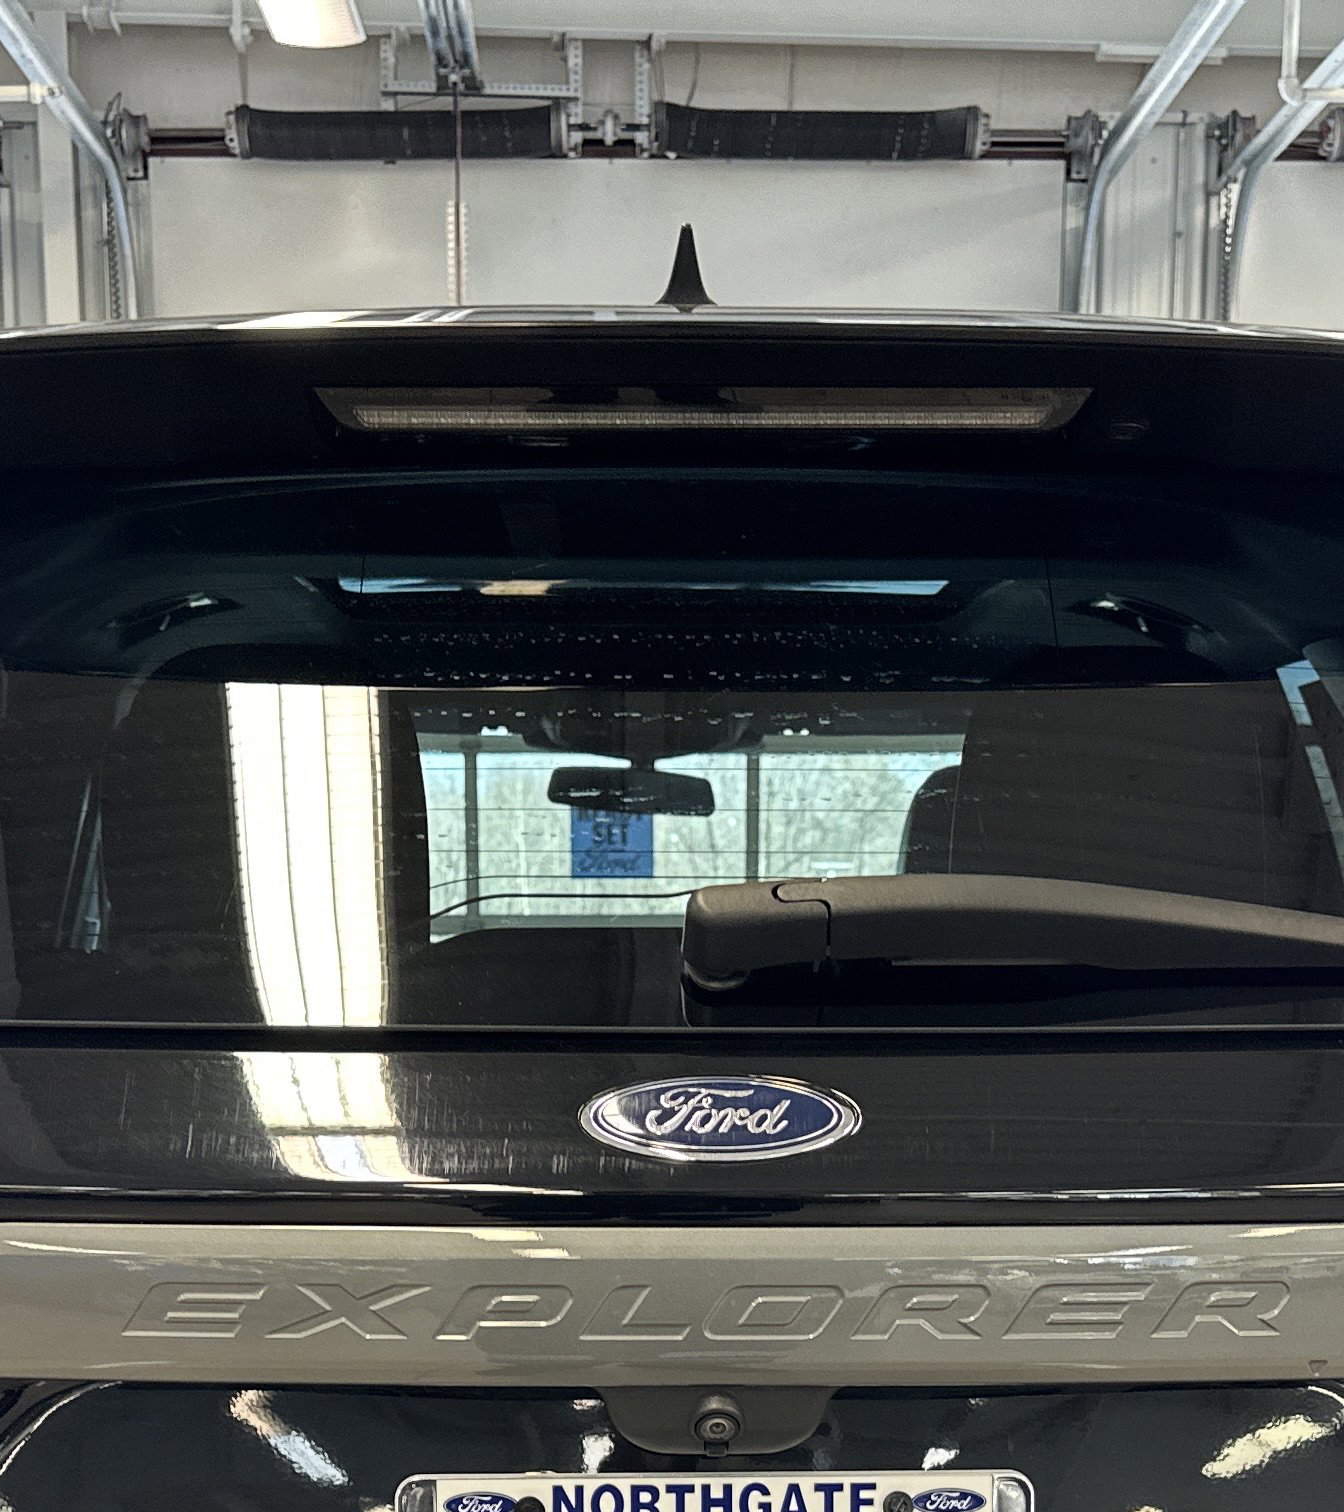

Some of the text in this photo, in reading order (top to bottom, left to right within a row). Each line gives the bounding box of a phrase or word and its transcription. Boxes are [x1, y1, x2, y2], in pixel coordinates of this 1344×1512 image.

[645, 1087, 791, 1135] Ford
[120, 1279, 1292, 1342] EXPLORER
[925, 1491, 972, 1510] Ford
